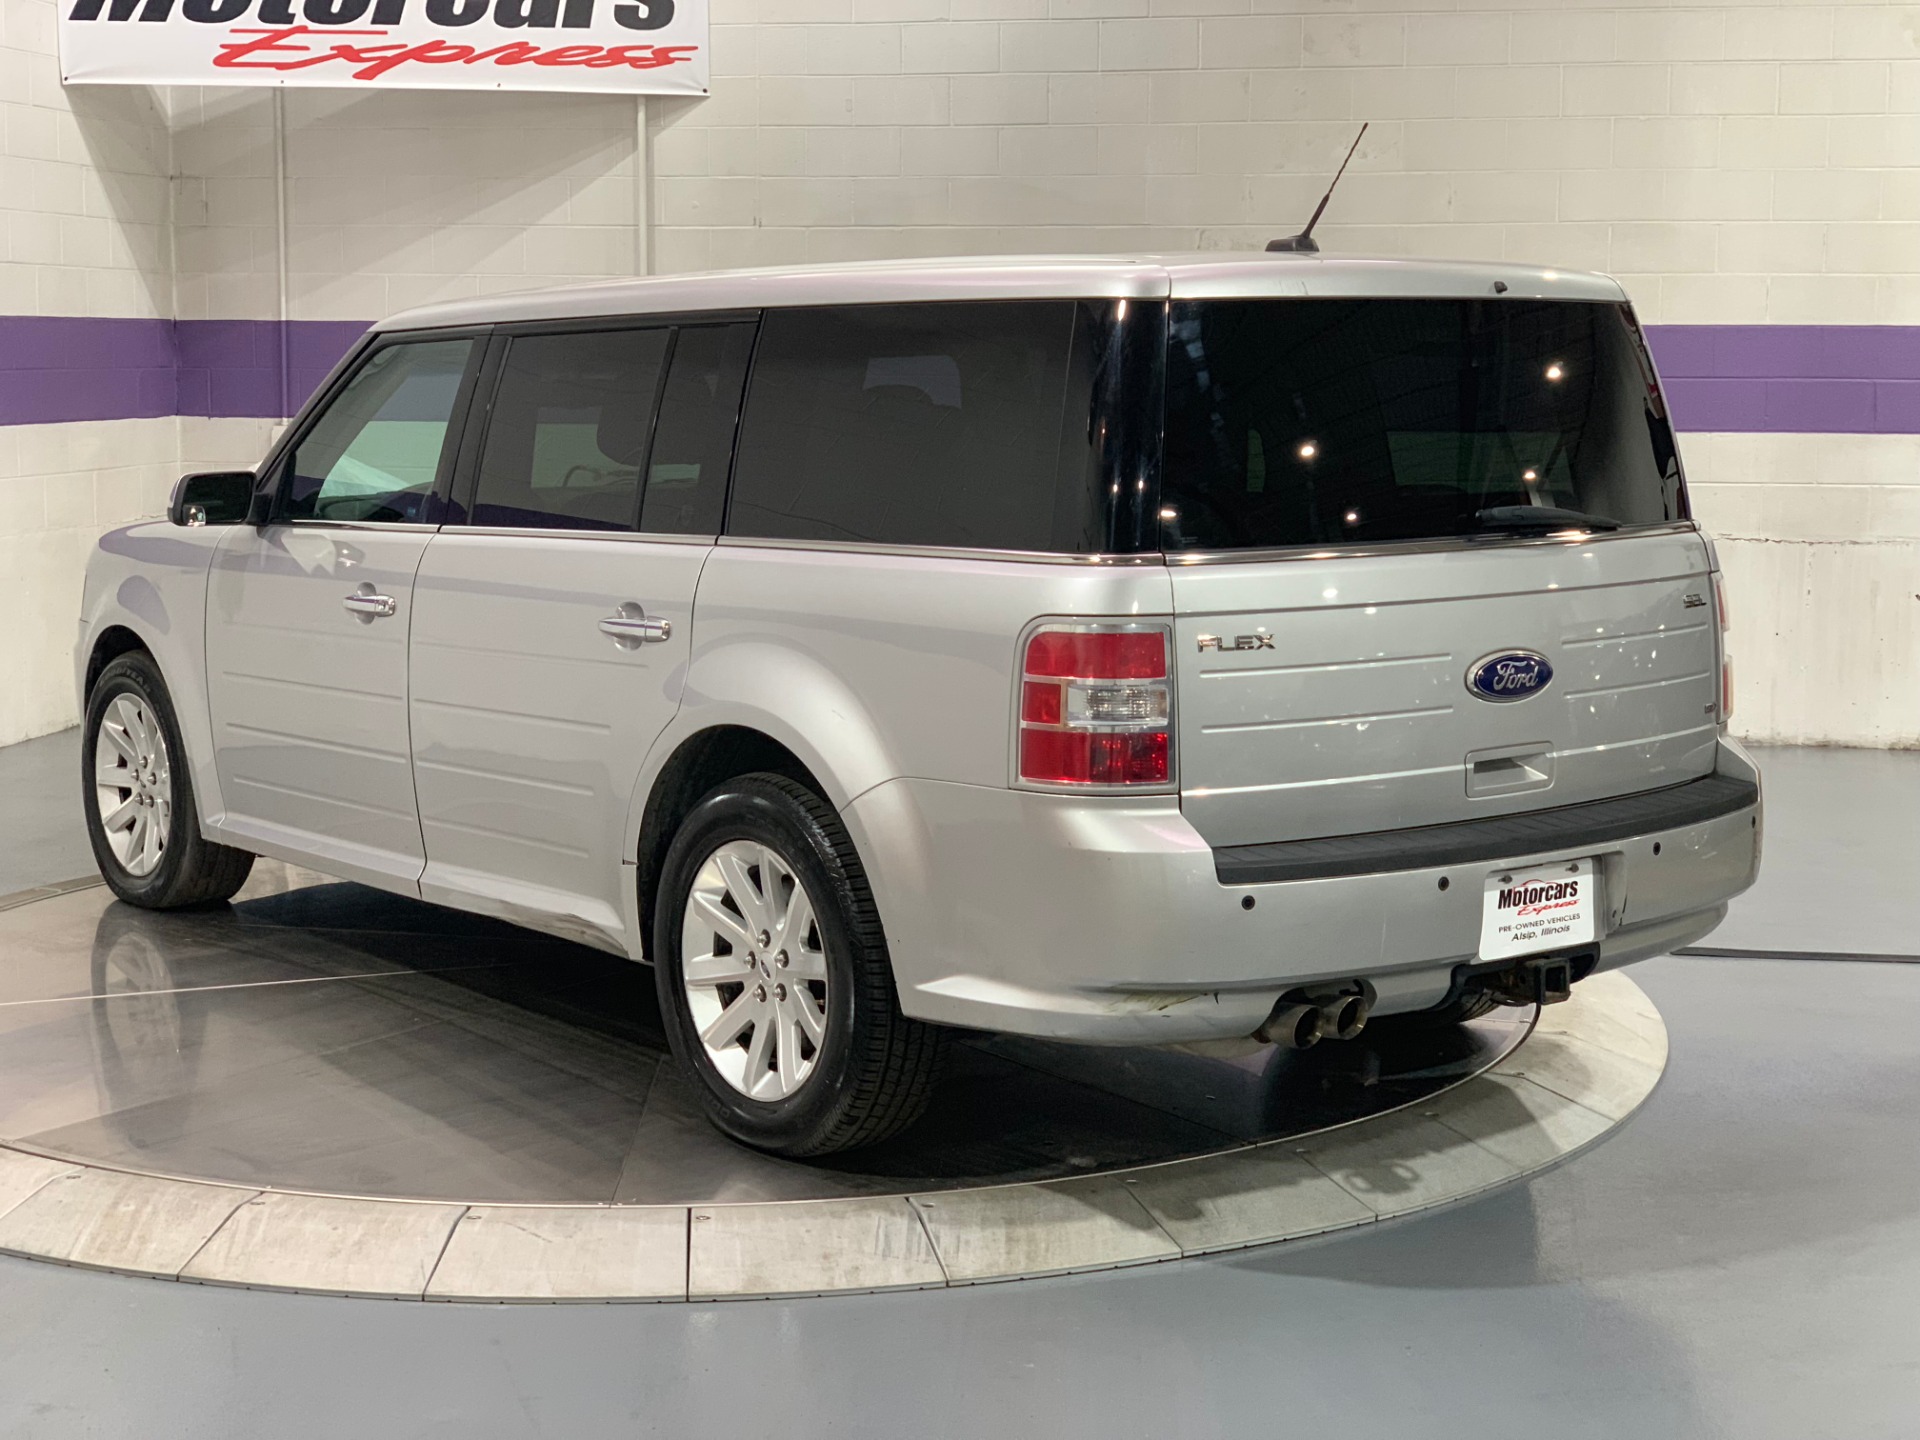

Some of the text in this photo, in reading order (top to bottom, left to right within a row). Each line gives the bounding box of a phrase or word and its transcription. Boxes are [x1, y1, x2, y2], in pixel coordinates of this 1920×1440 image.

[212, 25, 699, 80] Express
[1197, 634, 1276, 653] FLEX
[1493, 660, 1539, 690] Ford
[1498, 881, 1578, 910] Motorcars
[1517, 899, 1580, 916] Express
[1498, 912, 1581, 933] PRE-OWNED VEHICLES
[1511, 924, 1571, 942] Alsip, Illinois
